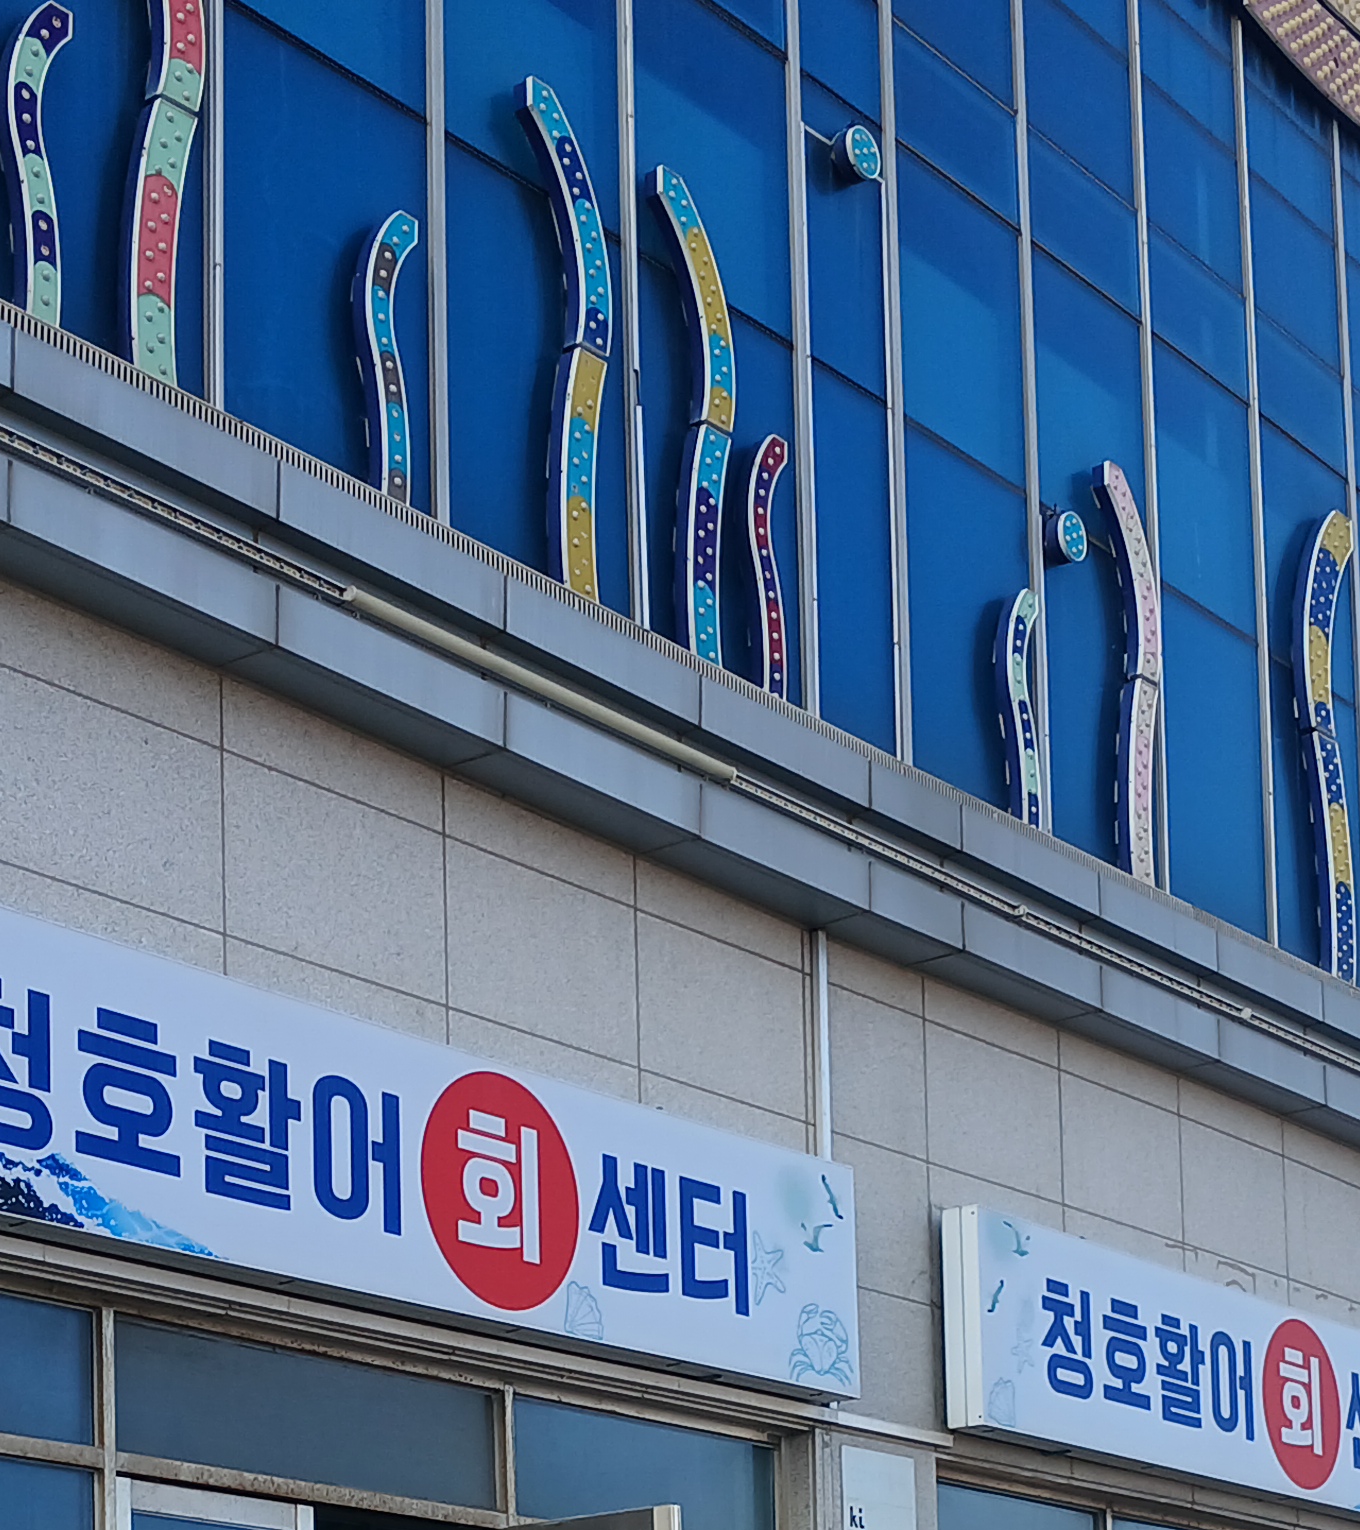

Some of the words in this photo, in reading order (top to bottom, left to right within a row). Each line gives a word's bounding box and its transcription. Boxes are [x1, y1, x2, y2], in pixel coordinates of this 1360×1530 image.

[456, 1110, 540, 1266] 회
[587, 1153, 751, 1317] 센터
[1040, 1278, 1254, 1442] 청호활어
[1279, 1347, 1323, 1456] 회
